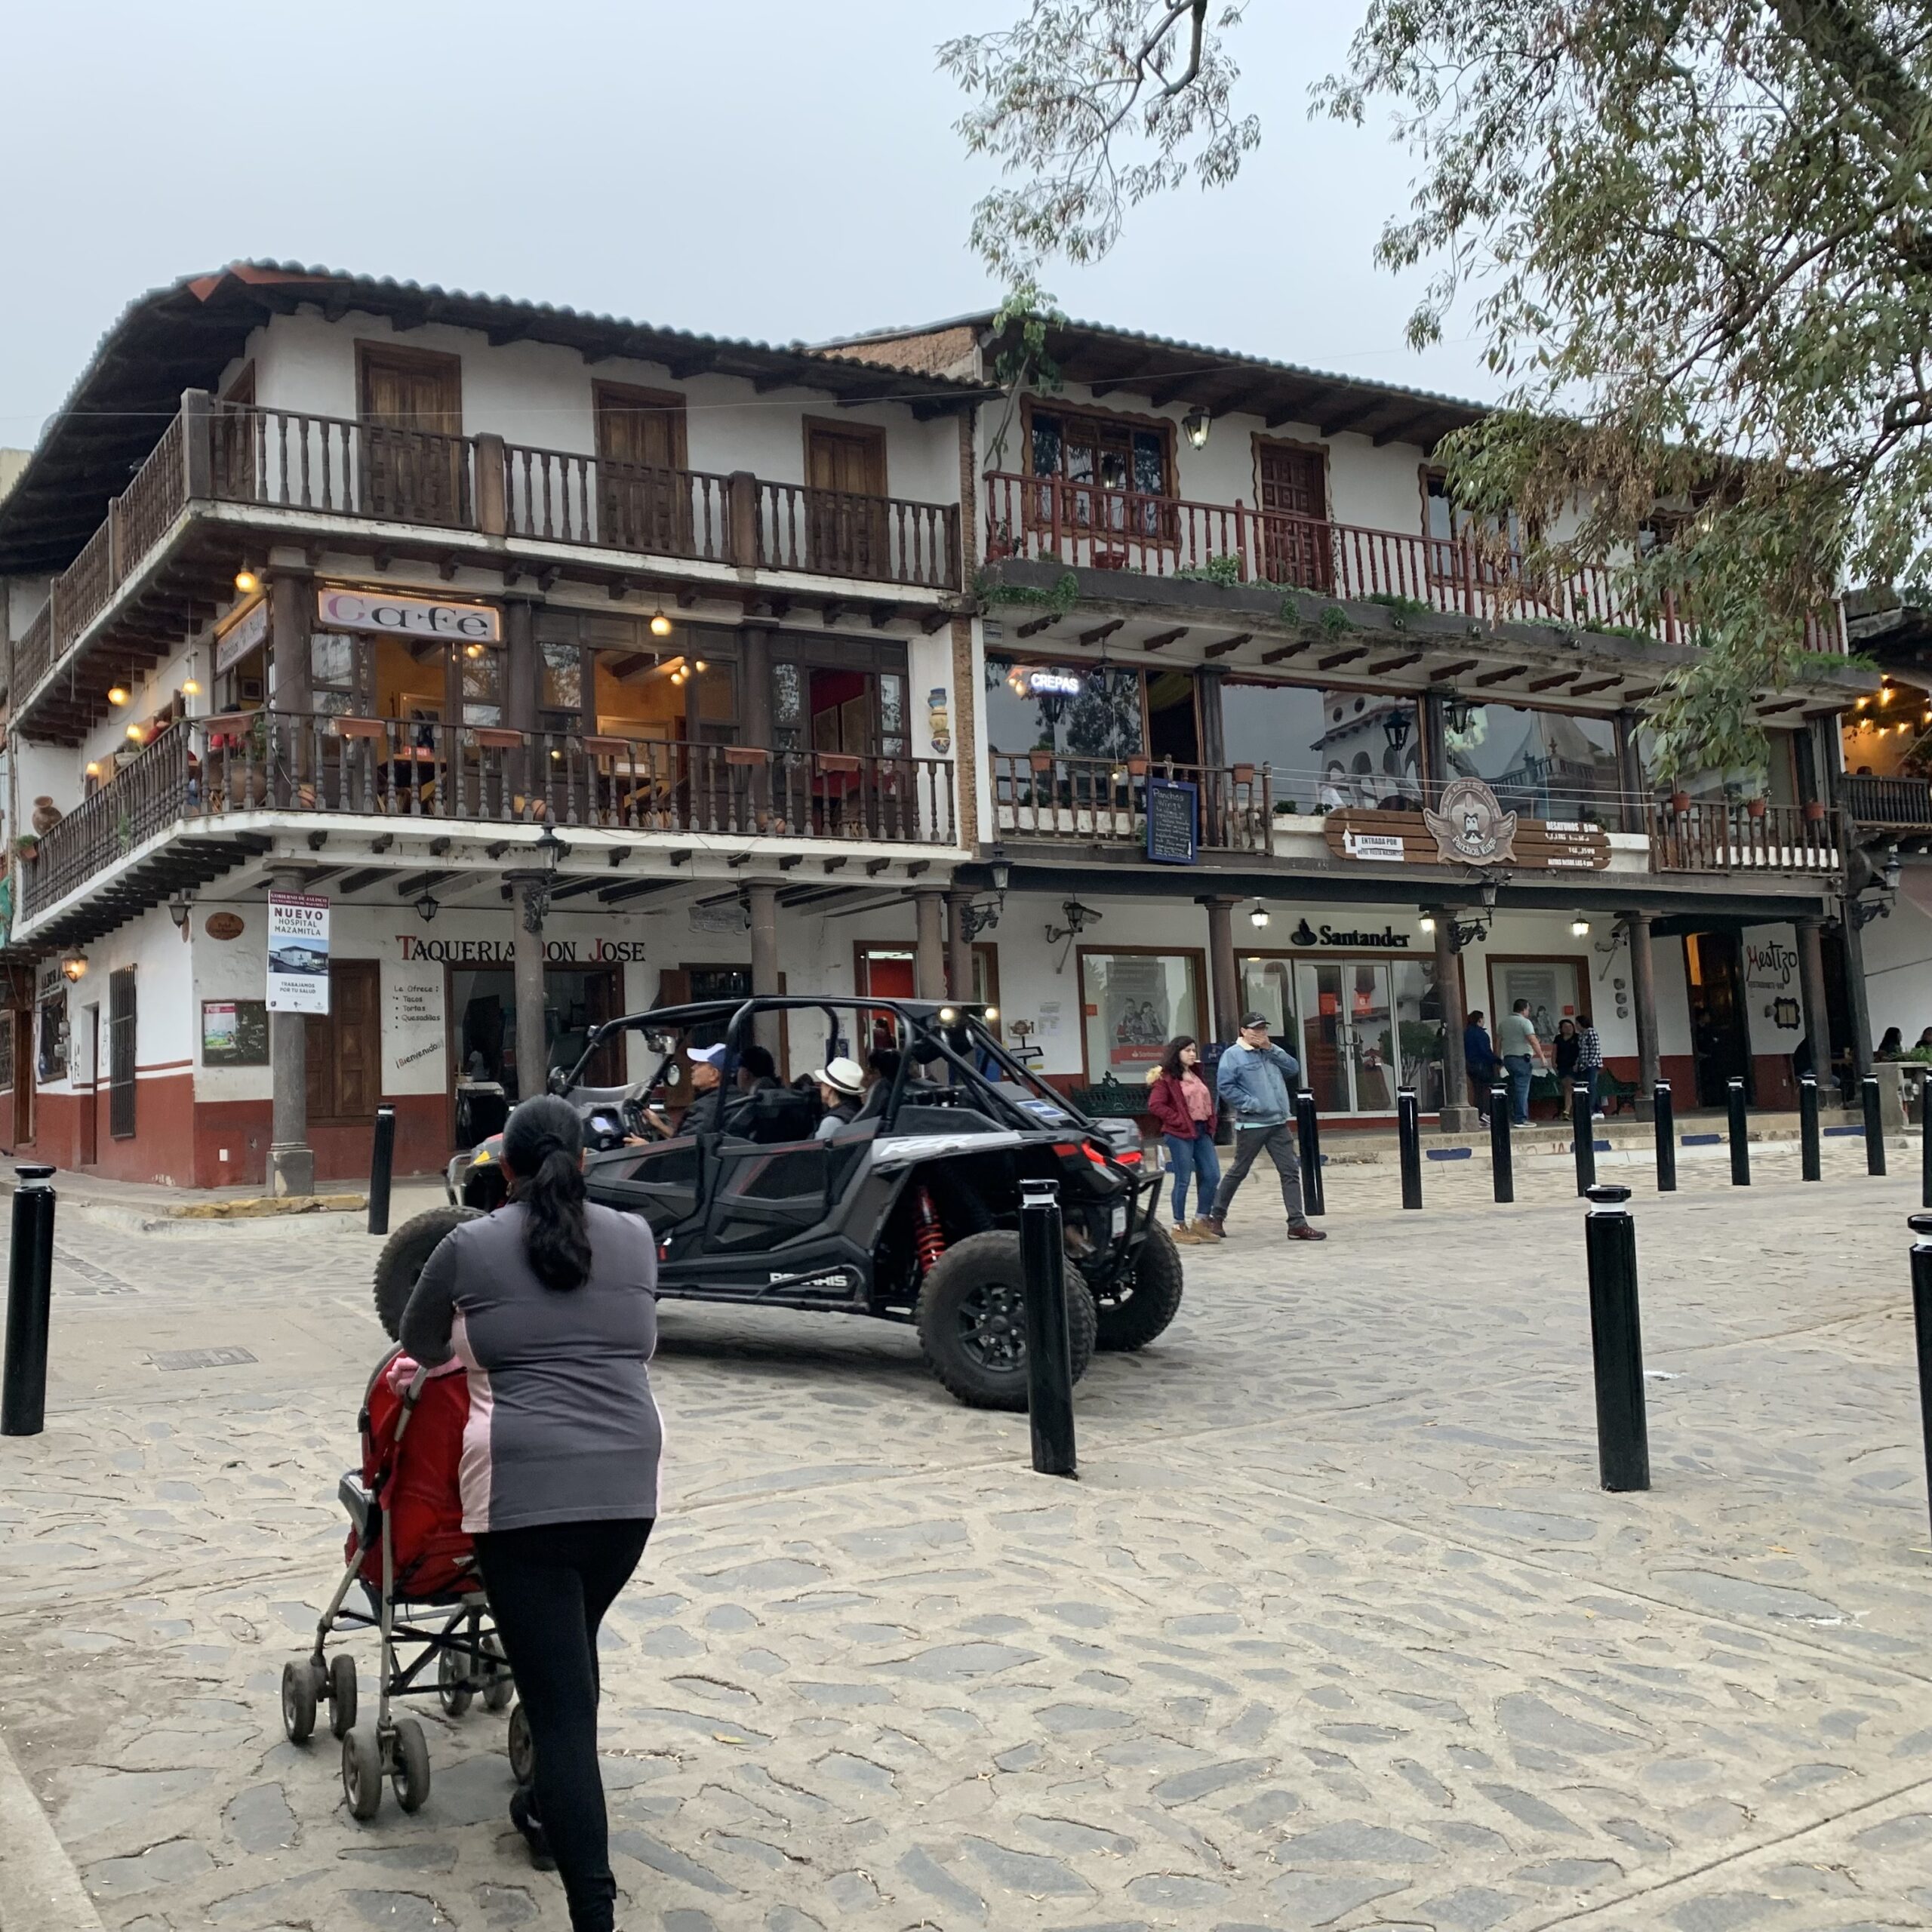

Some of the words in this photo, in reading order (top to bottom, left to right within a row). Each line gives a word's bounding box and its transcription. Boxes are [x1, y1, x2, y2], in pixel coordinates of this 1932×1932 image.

[328, 595, 488, 637] Café
[1030, 673, 1079, 694] CREPAS
[1152, 788, 1183, 801] Panchos
[1361, 837, 1386, 845] ENTRADA
[1452, 835, 1479, 856] Panchos
[275, 907, 323, 921] NUEVO
[278, 918, 317, 928] HOSPITAL
[275, 925, 321, 936] MAZAMITLA
[1320, 924, 1410, 947] Santander
[395, 935, 515, 961] TAQUERIA
[588, 938, 646, 961] JOSE
[1746, 940, 1798, 984] Mestizo
[401, 1014, 441, 1023] Quesadillas
[879, 1135, 972, 1156] RZR
